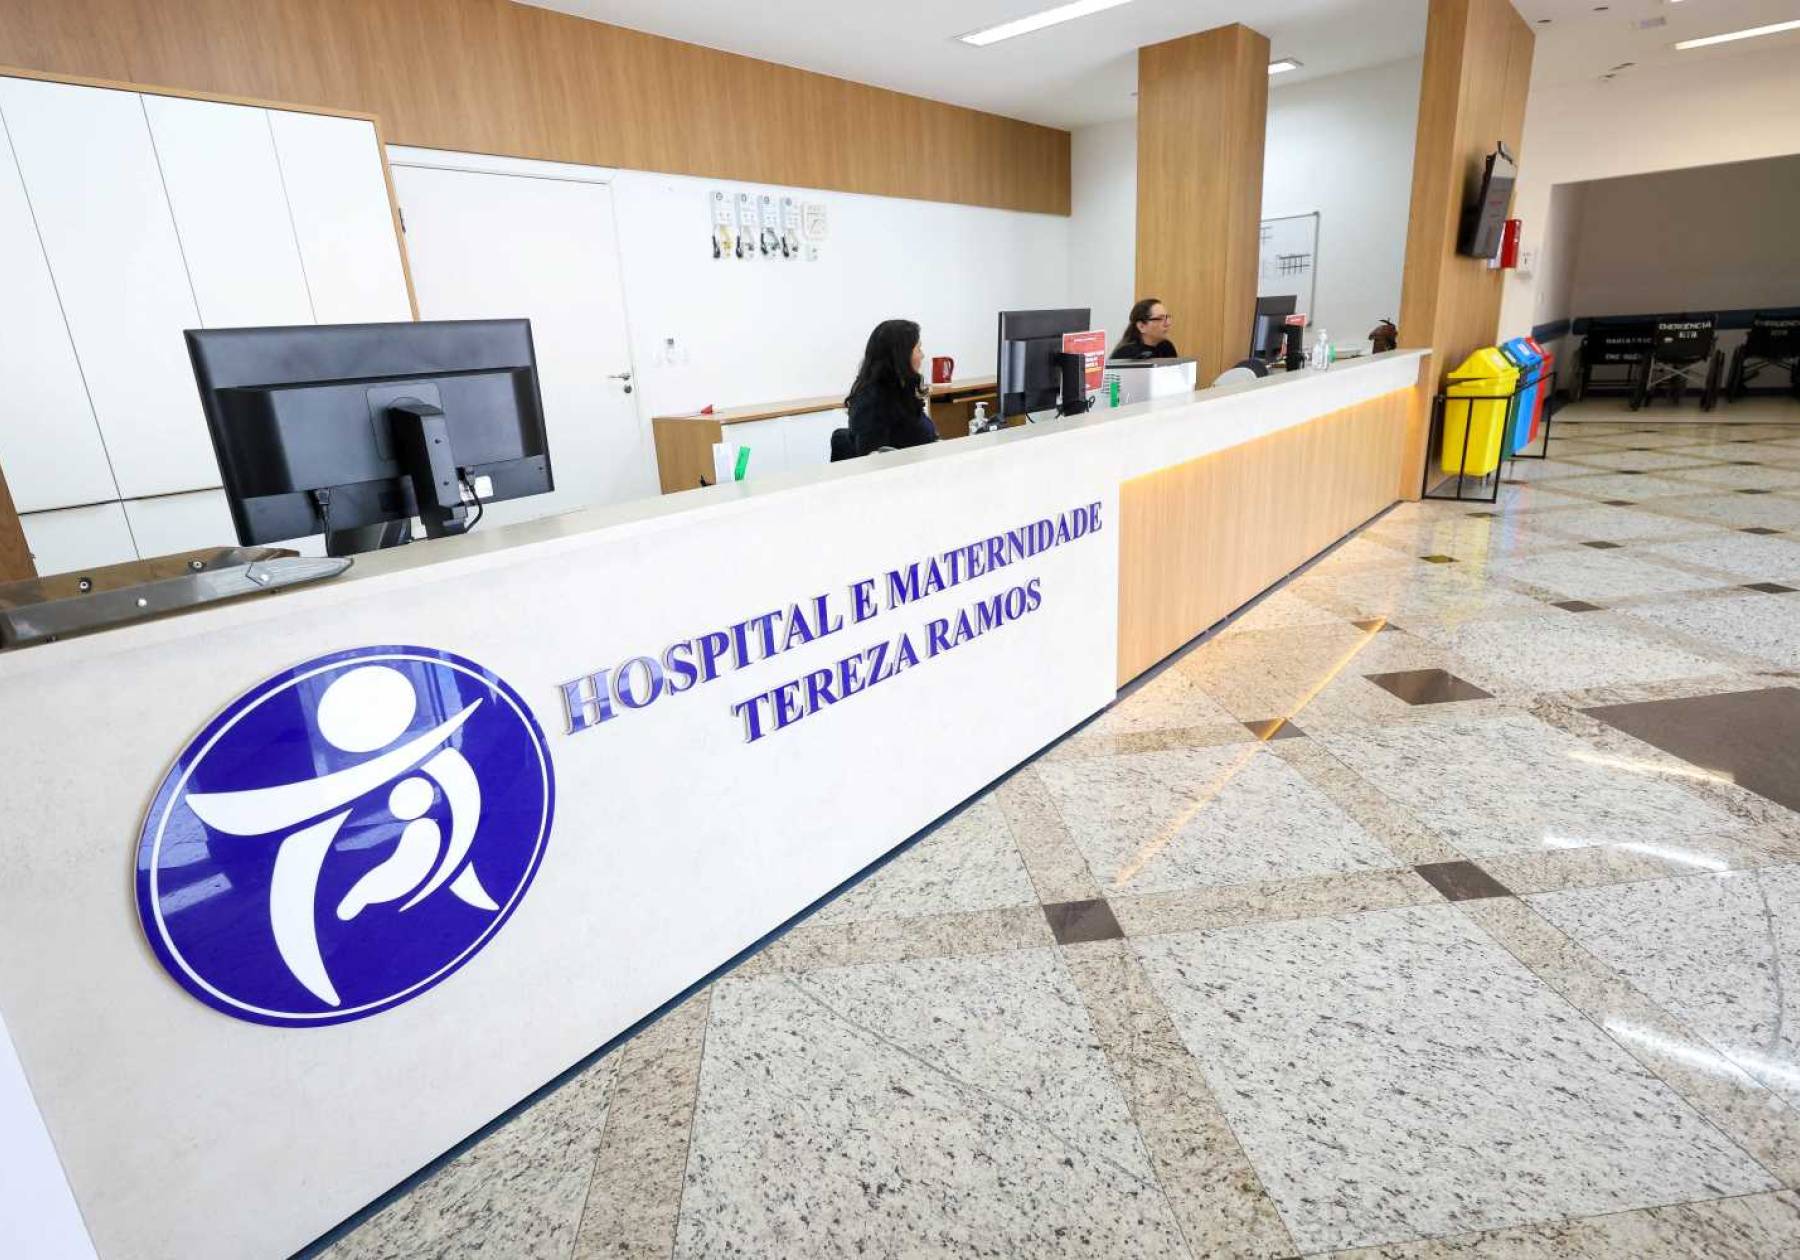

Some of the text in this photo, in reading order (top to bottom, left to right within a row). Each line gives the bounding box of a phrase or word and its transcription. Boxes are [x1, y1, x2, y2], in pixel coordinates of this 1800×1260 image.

[558, 501, 1104, 736] HOSPITAL E MATERNIDADE
[732, 577, 1043, 744] TEREZA RAMOS
